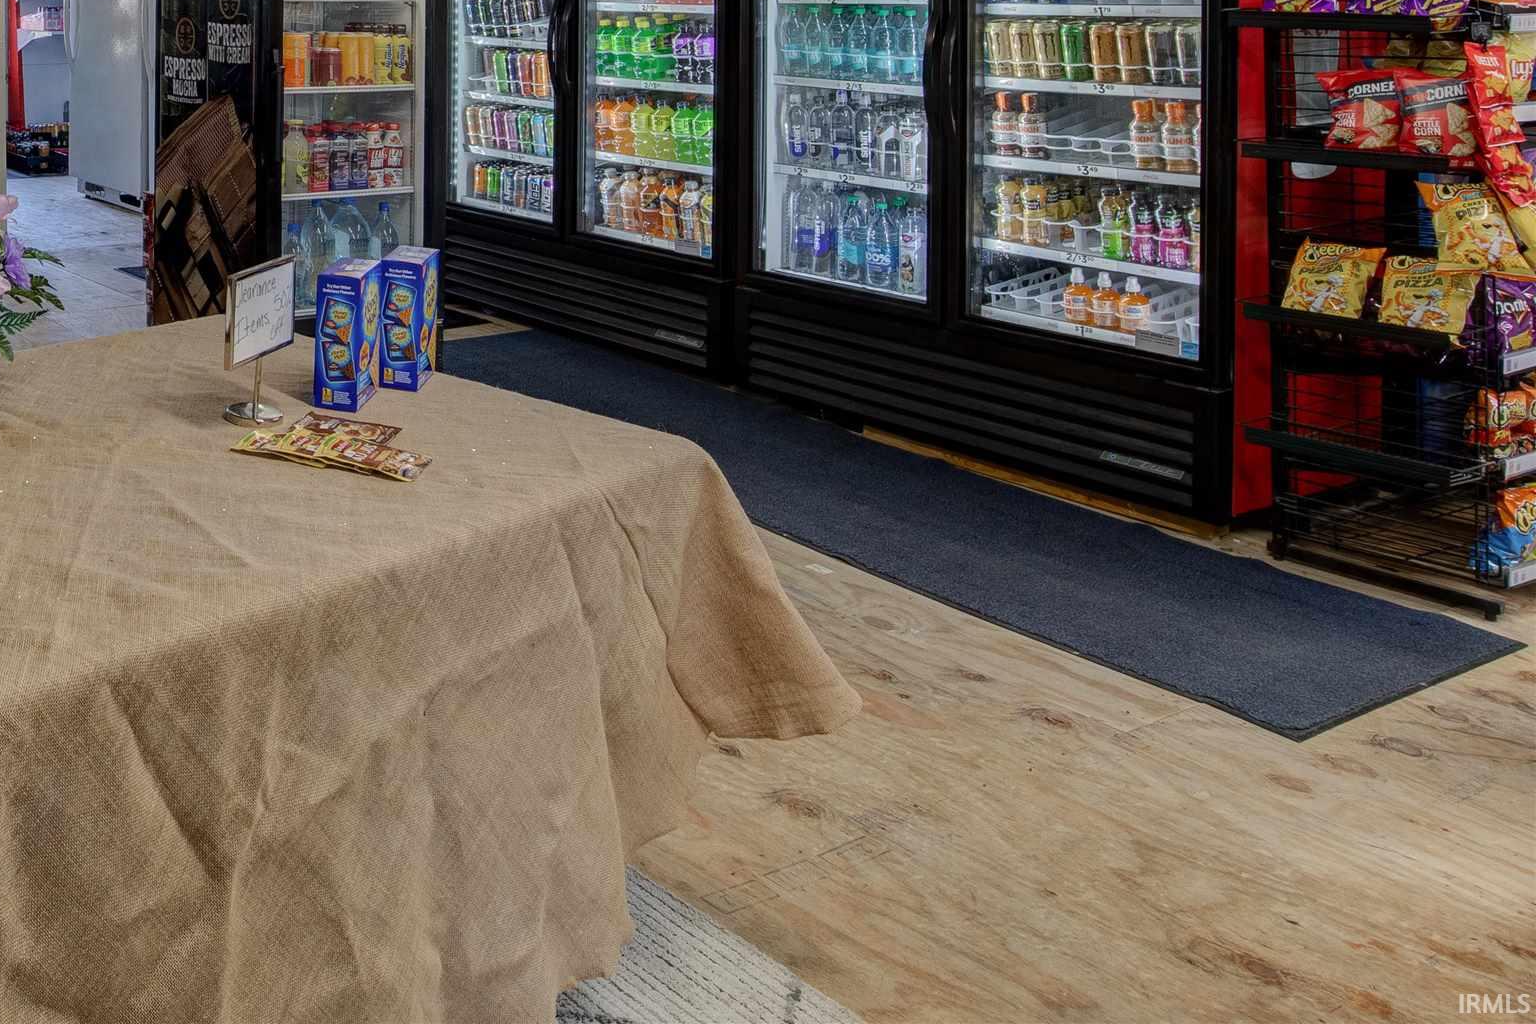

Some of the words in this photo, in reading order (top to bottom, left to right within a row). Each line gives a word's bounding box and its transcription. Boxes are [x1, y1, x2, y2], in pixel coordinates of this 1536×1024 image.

[207, 22, 252, 47] ESPRESSO
[208, 44, 224, 63] WITH
[227, 47, 250, 64] CREAM
[164, 56, 206, 80] ESPRESSO
[172, 79, 198, 97] MOCHA
[1414, 127, 1441, 136] CORN
[1393, 277, 1444, 288] PIZZA
[236, 312, 270, 344] Items
